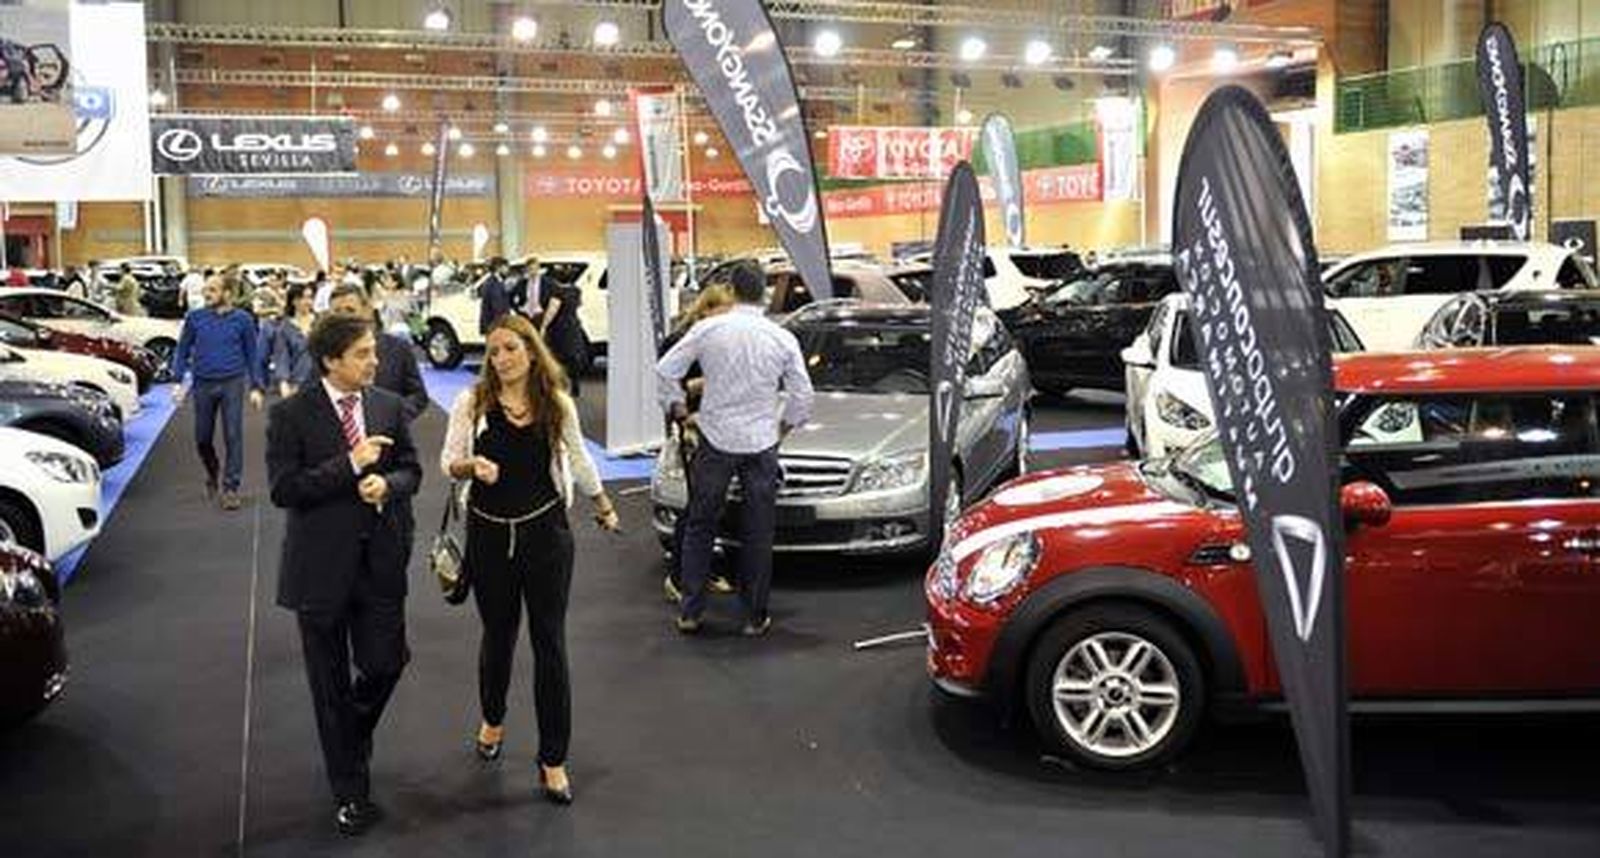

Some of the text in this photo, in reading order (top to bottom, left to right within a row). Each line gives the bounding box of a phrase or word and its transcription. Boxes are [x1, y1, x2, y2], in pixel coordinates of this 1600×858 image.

[210, 133, 337, 151] LEXUS
[878, 138, 963, 159] TOYOTA
[239, 154, 313, 167] SEVILLA
